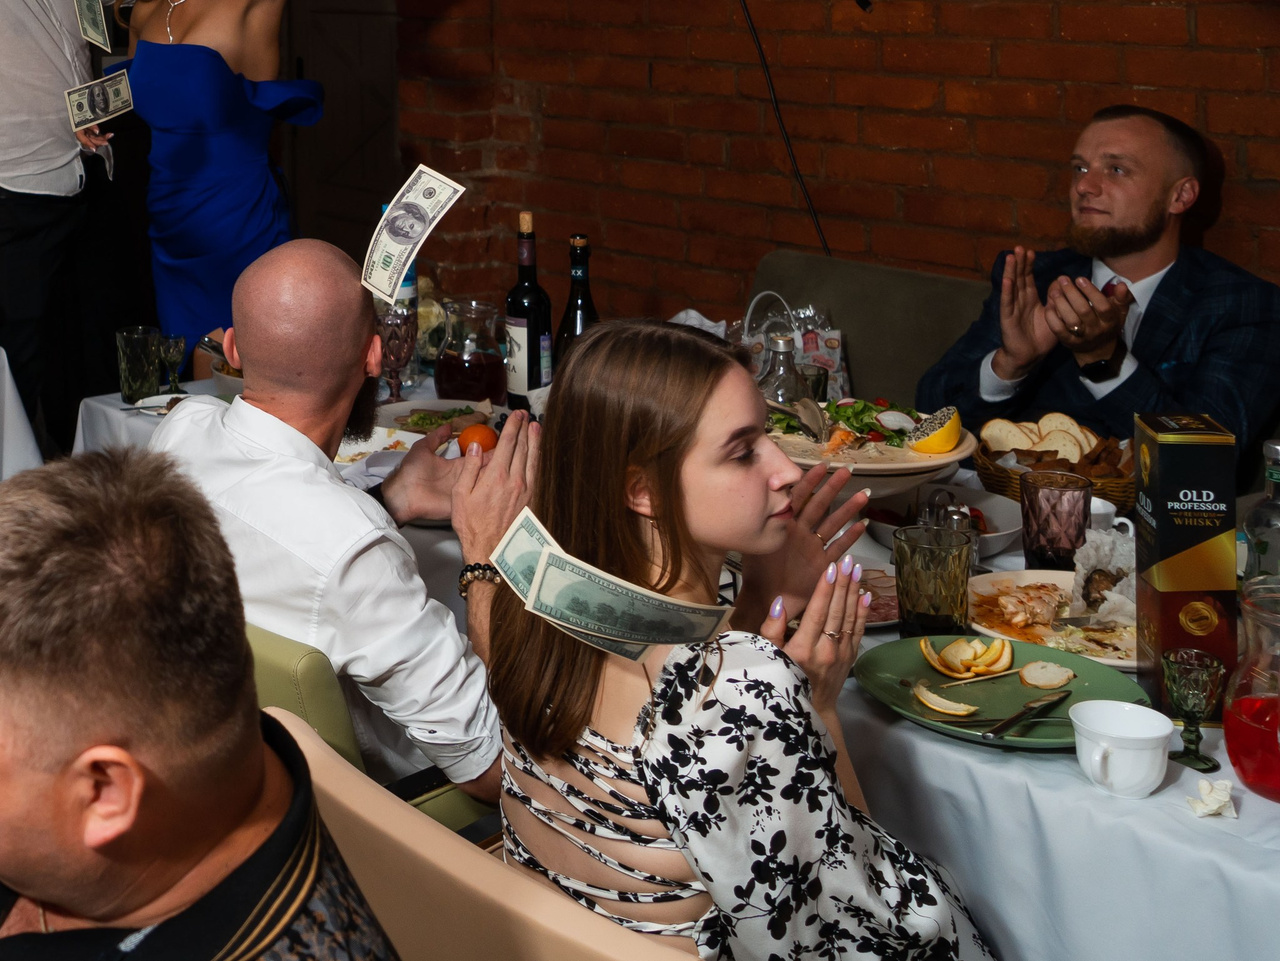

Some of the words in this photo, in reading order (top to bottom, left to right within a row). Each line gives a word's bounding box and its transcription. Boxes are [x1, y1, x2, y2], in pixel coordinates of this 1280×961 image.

[1138, 491, 1152, 513] OLD
[1179, 489, 1215, 502] OLD
[1167, 501, 1227, 511] PROFESSOR
[1173, 517, 1222, 527] WHISKY
[518, 582, 529, 595] ON
[585, 572, 616, 591] UNITED
[615, 587, 650, 603] STATES
[649, 598, 658, 606] OF
[658, 600, 706, 615] AMERICA
[569, 616, 588, 628] ONE
[587, 623, 631, 638] HUNDRED
[631, 634, 673, 643] DOLLARS
